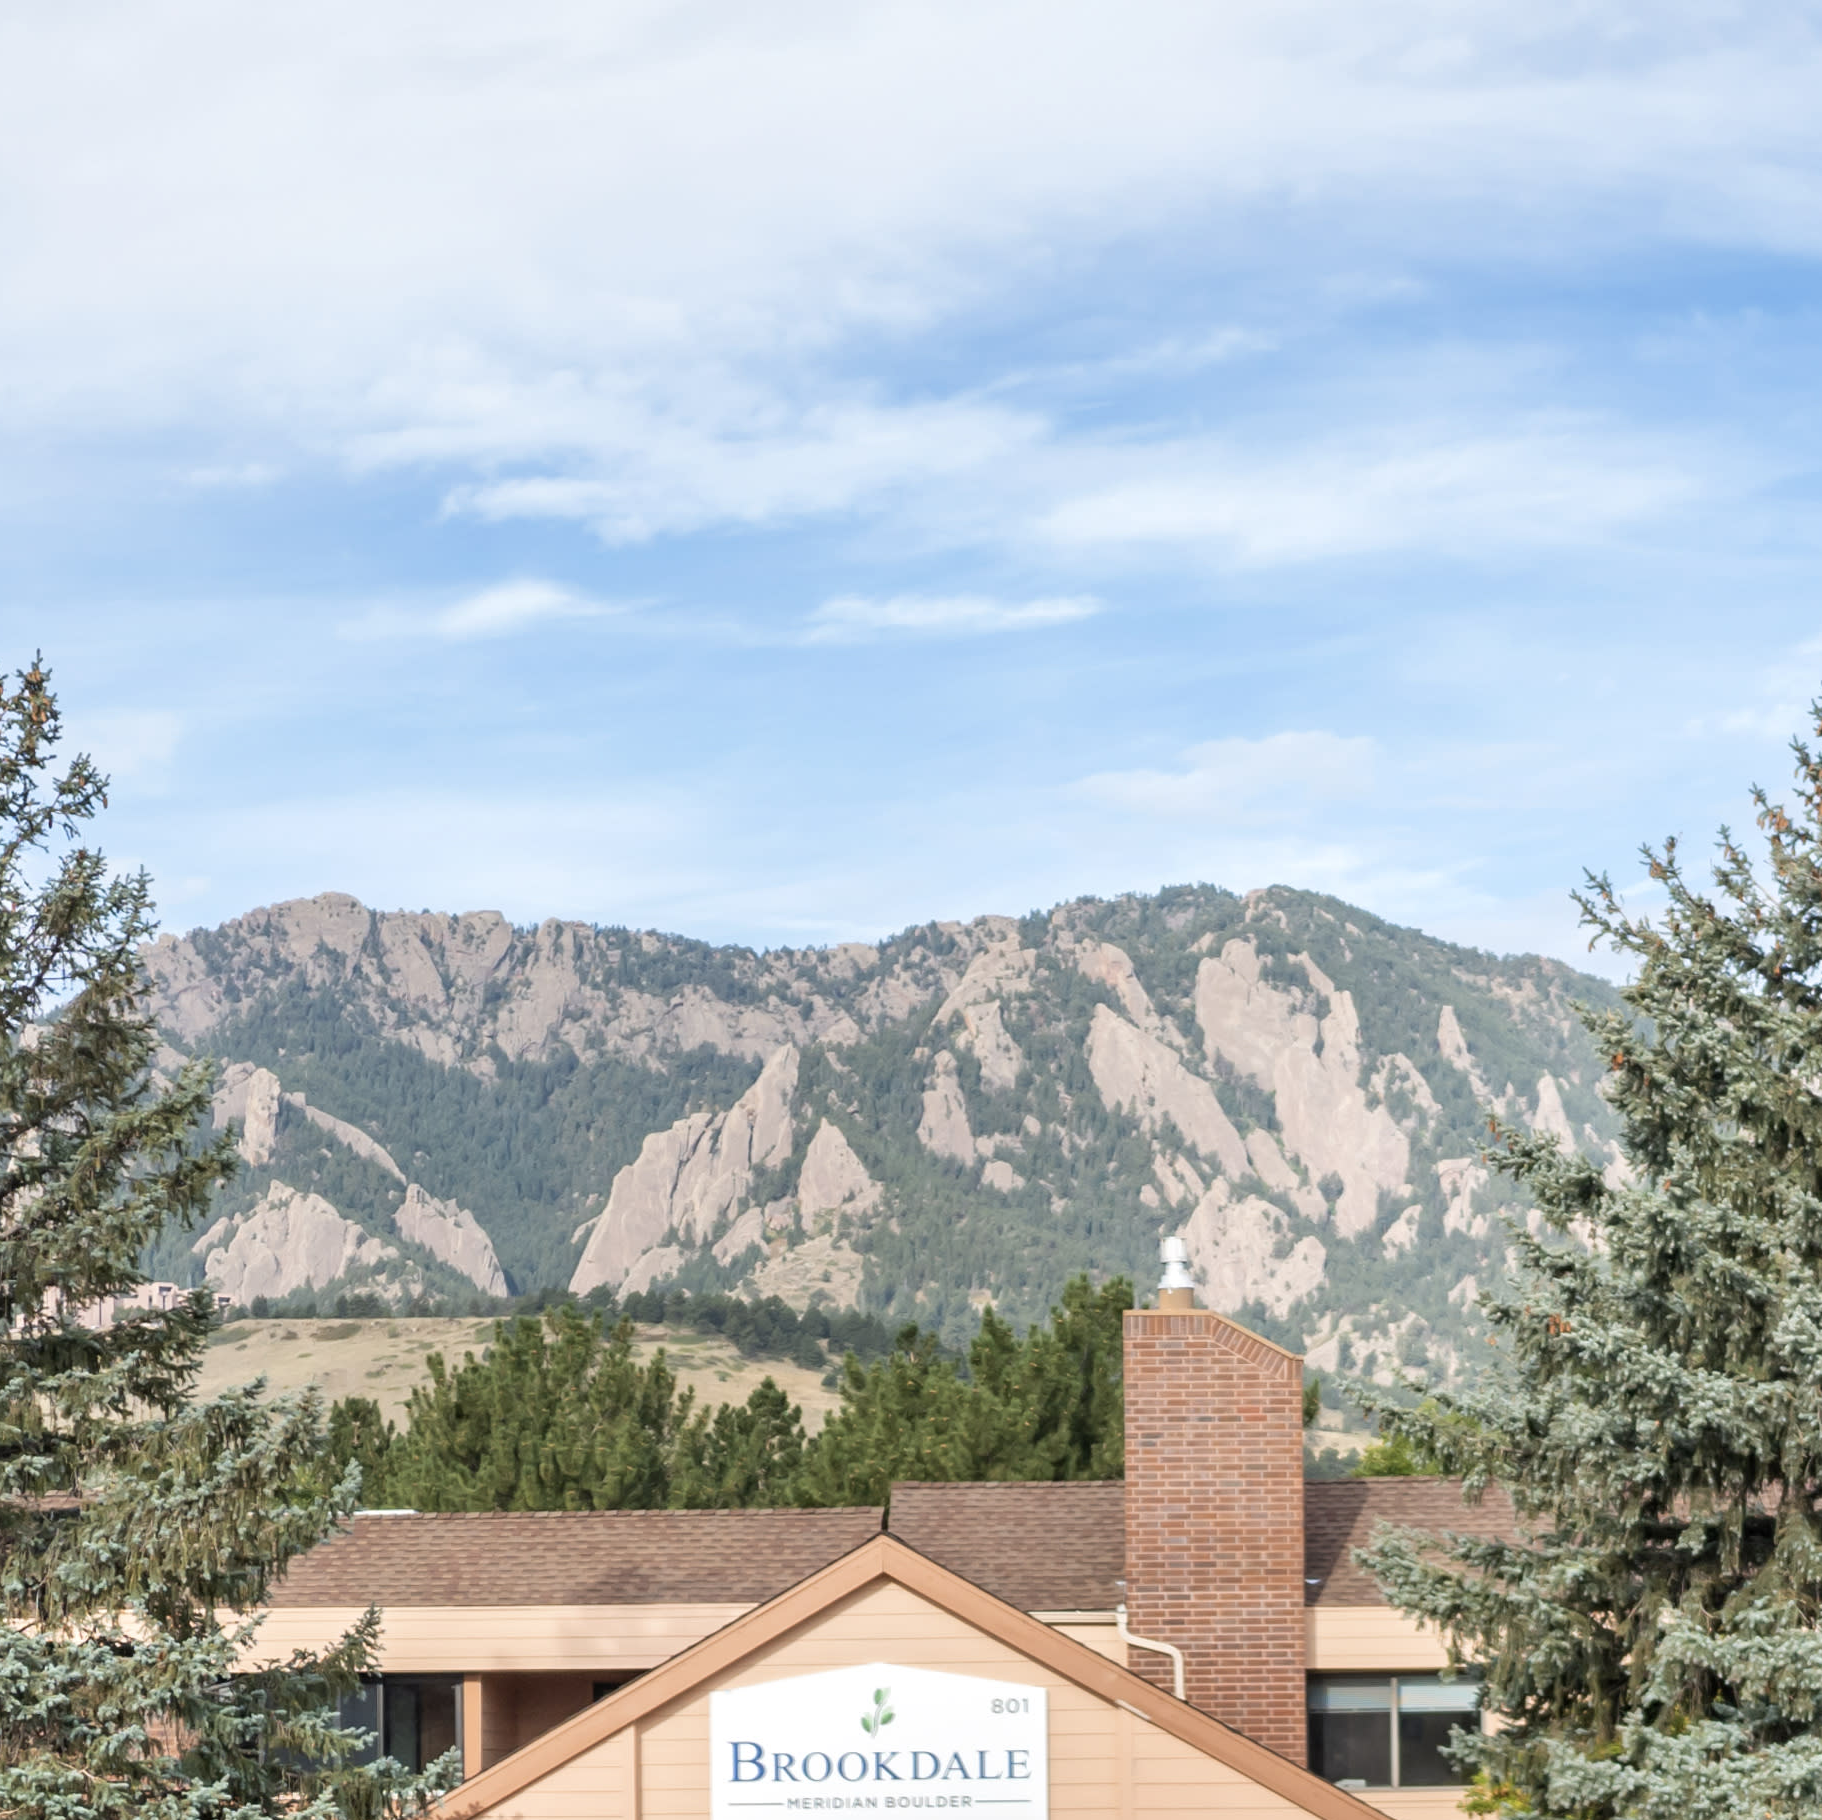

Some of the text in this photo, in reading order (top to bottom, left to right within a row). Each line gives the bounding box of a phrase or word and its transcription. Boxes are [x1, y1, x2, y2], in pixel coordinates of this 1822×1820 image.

[991, 1698, 1030, 1714] 801
[727, 1741, 1033, 1783] BROOKDALE
[787, 1795, 973, 1810] MERIDIAN BOULDER
